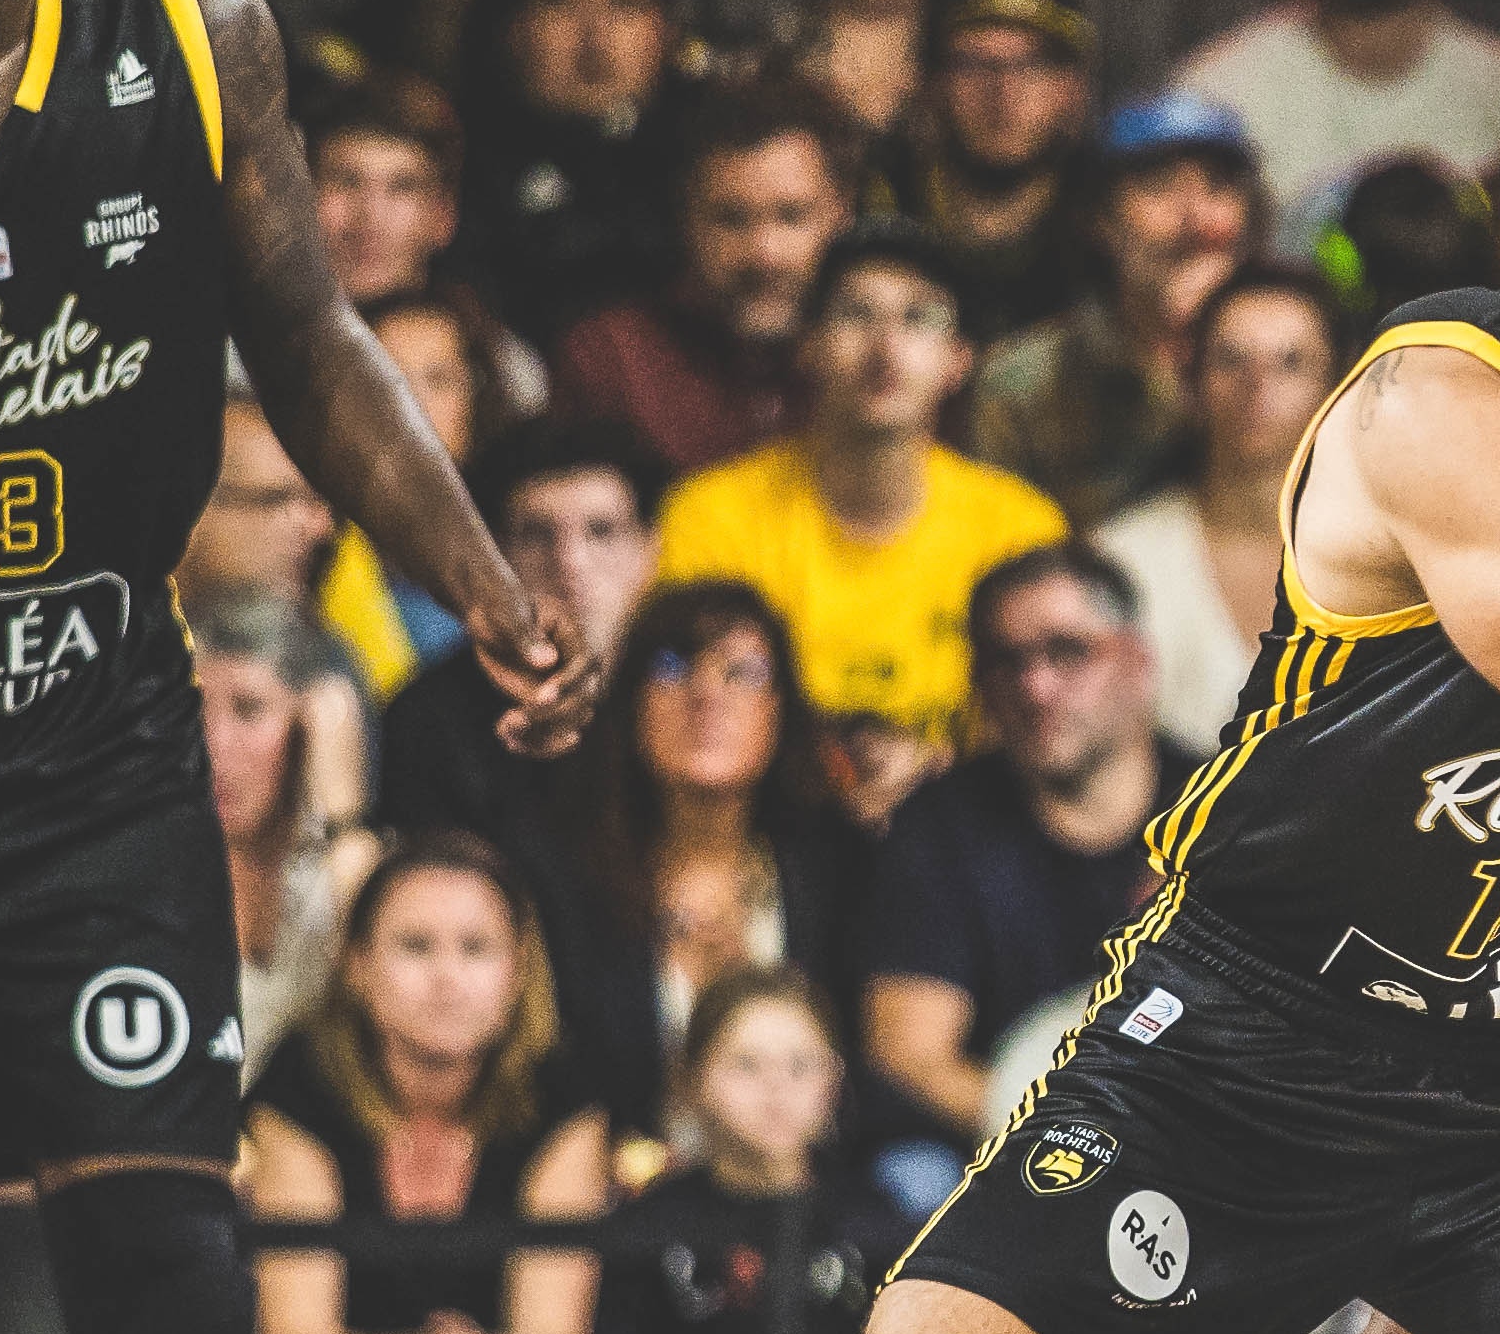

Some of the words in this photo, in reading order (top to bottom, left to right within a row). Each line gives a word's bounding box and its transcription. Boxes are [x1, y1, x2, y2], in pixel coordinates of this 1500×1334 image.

[83, 205, 160, 248] RHINOS
[1043, 1128, 1115, 1166] ROCHELAIS
[1068, 1123, 1102, 1142] STADE
